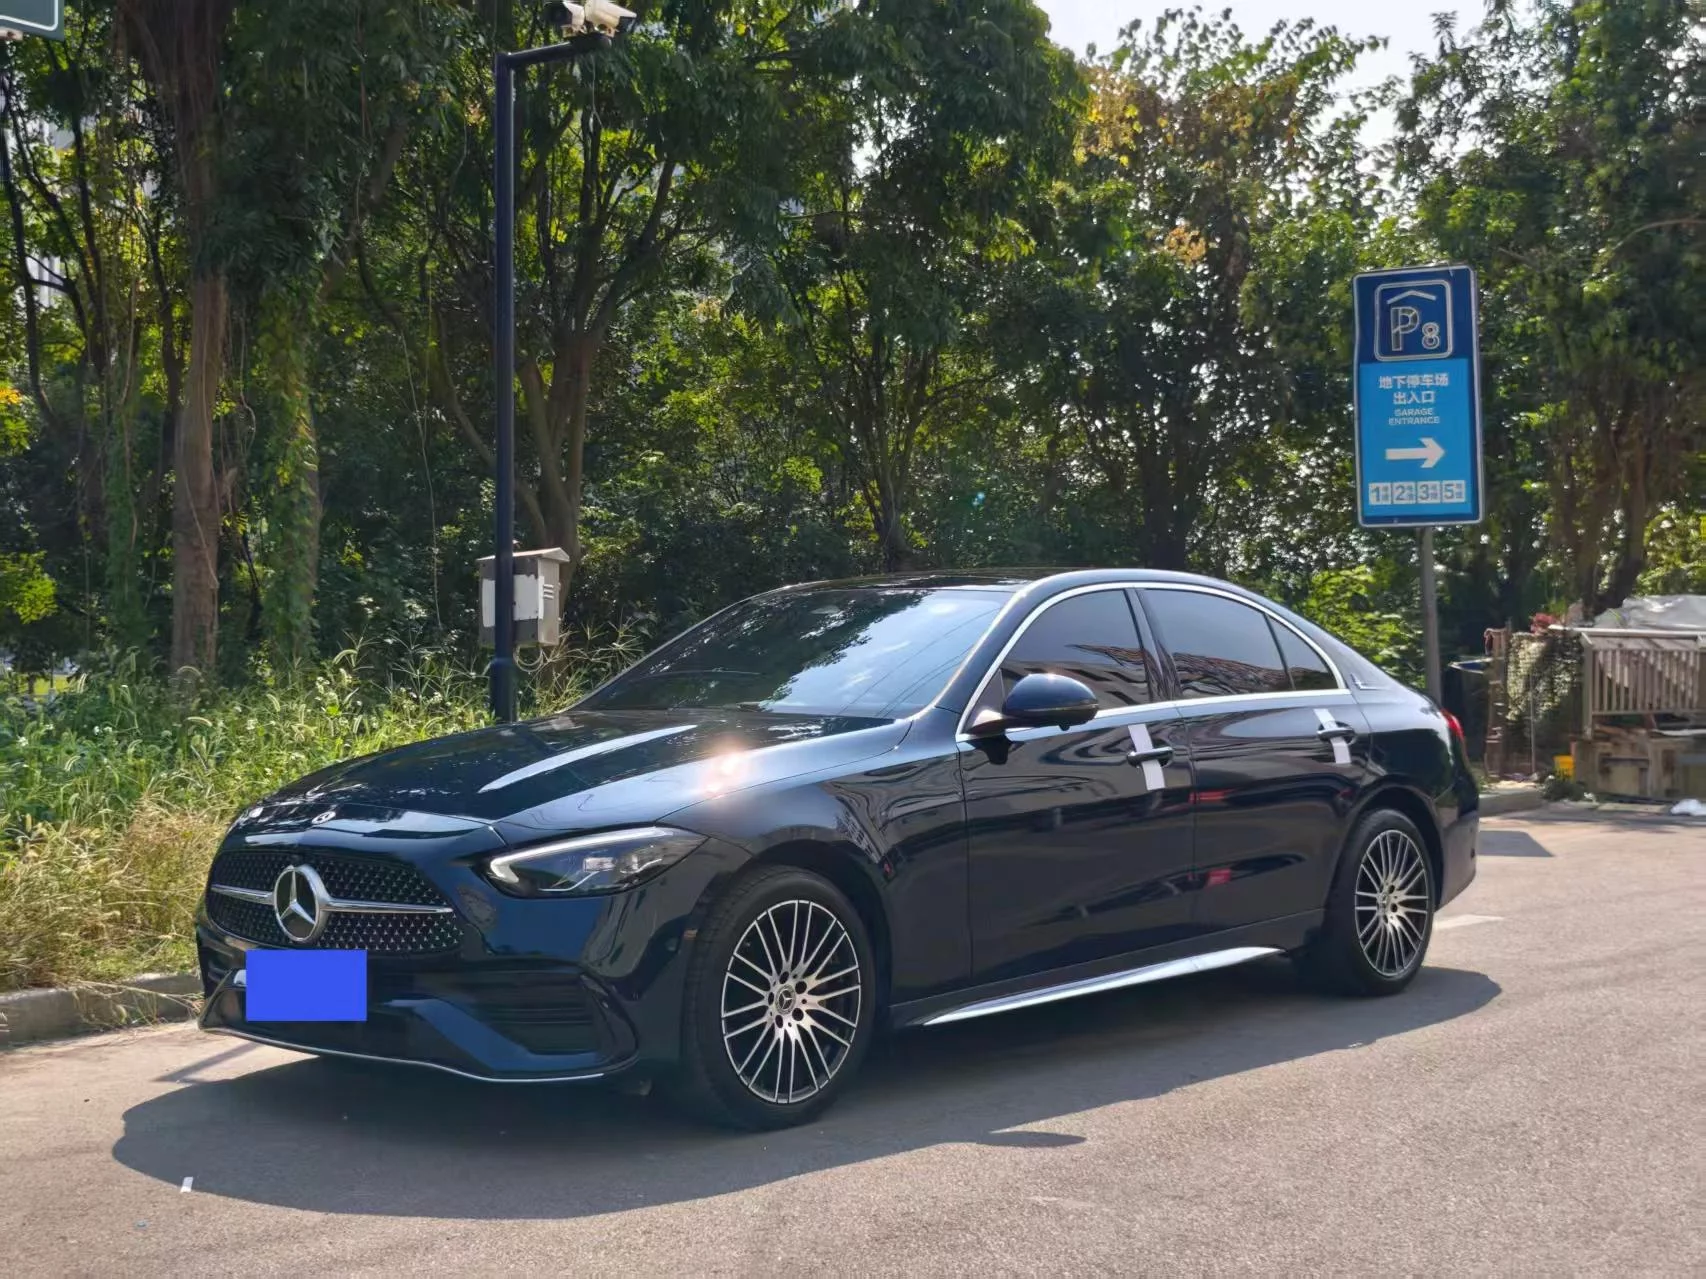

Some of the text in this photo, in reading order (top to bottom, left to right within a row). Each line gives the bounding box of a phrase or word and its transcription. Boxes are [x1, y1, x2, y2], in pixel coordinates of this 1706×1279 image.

[1379, 373, 1449, 389] 地下停车场
[1393, 391, 1435, 405] 出入口
[1394, 408, 1433, 417] GARAGE
[1388, 416, 1440, 426] ENTRANCE
